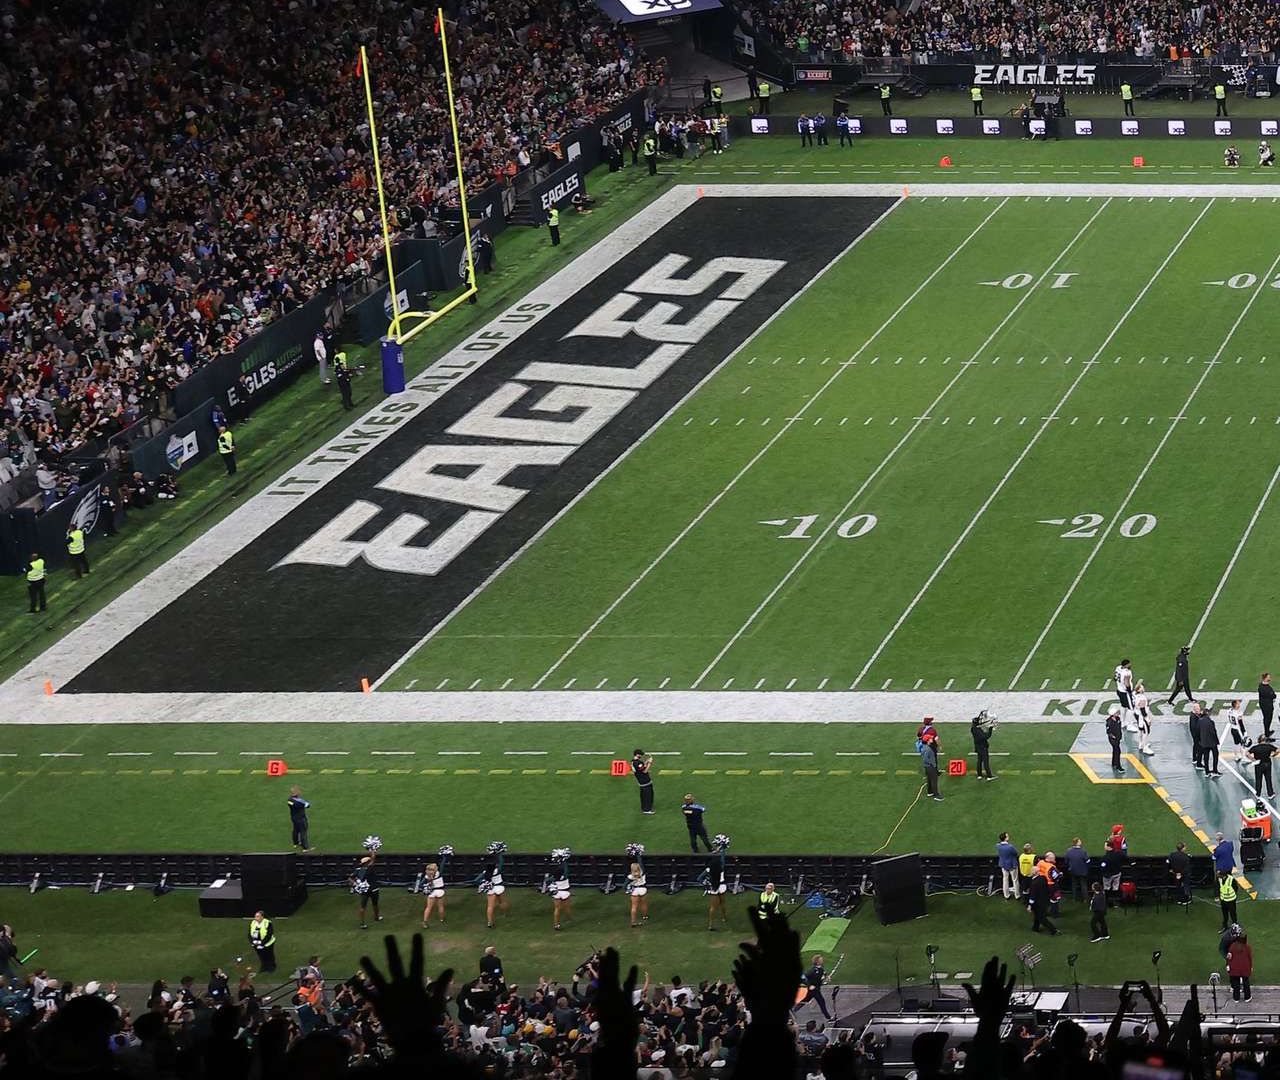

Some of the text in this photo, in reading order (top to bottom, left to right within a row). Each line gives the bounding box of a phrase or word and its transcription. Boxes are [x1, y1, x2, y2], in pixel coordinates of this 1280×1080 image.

[973, 65, 1097, 85] EAGLES
[540, 172, 581, 211] EAGLES
[267, 303, 551, 496] IT TAKES ALL OF US
[270, 252, 787, 576] EAGLES
[777, 514, 878, 539] 10
[1060, 513, 1158, 539] 20
[270, 762, 279, 774] G
[613, 762, 624, 774] 10
[950, 762, 963, 773] 20
